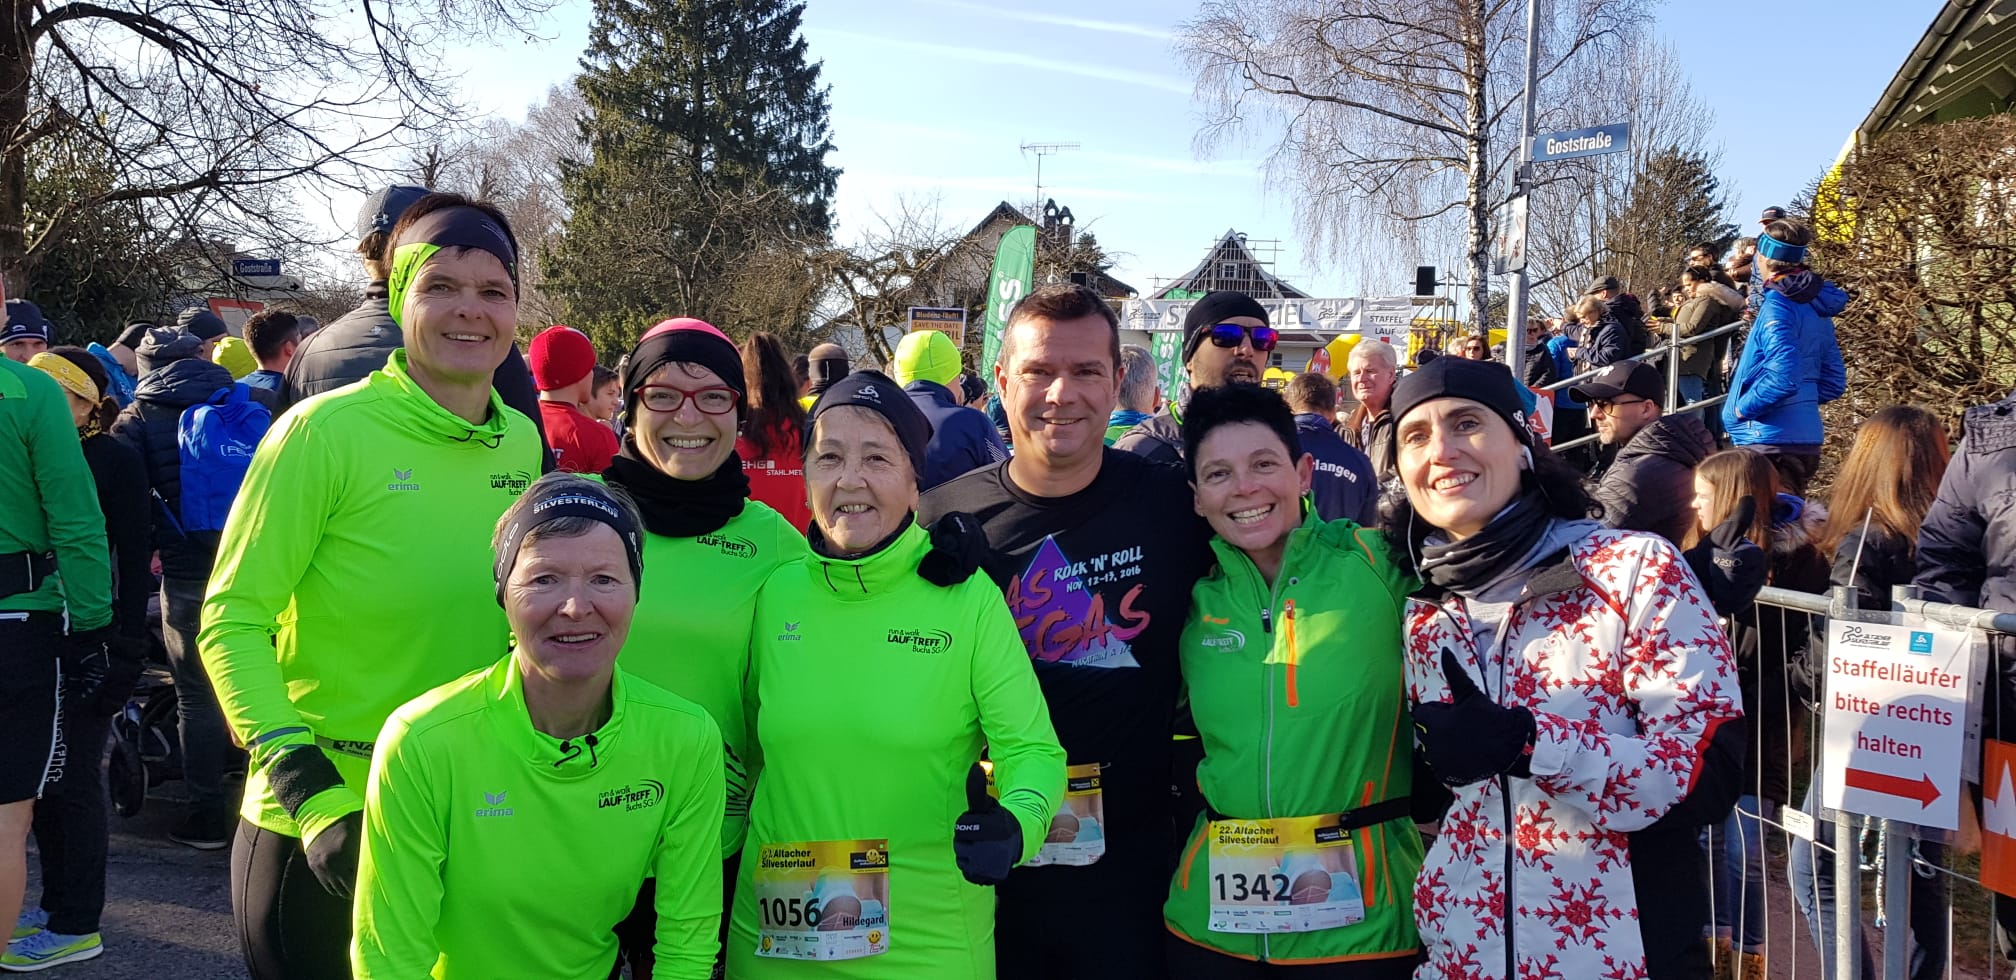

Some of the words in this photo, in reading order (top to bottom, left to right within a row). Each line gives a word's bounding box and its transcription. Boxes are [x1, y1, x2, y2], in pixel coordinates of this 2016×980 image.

[1547, 131, 1612, 155] Goststraße
[1370, 315, 1403, 323] STAFFEL
[945, 331, 960, 340] RIL
[1375, 327, 1395, 335] LAUF
[1312, 459, 1357, 483] langen
[388, 482, 420, 491] erima
[490, 480, 527, 489] LAUF-TREFF
[696, 535, 746, 552] LAUF-TREFF
[1054, 561, 1087, 582] ROCK
[1112, 546, 1143, 567] ROLL
[1066, 581, 1083, 593] NOV
[1088, 571, 1117, 586] 12-13,
[1120, 565, 1141, 579] 2016
[1006, 568, 1052, 614] AS
[777, 633, 801, 641] erima
[887, 634, 941, 647] LAUF-TREFF
[912, 645, 931, 654] Buchs
[931, 646, 941, 654] SG
[1832, 656, 1961, 688] Staffelläufer
[1835, 691, 1880, 715] bitte
[1887, 703, 1952, 726] rechts
[1857, 730, 1922, 759] halten
[599, 789, 609, 798] run
[615, 785, 631, 796] walk
[599, 789, 651, 808] LAUF-TREFF
[626, 801, 642, 812] Buchs
[643, 798, 654, 808] SG
[475, 807, 513, 817] erima
[1219, 826, 1233, 835] 22.
[1234, 826, 1274, 835] Altacher
[1219, 835, 1279, 844] Silvesterlauf
[774, 849, 811, 858] Altacher
[762, 858, 816, 868] Silvesterlauf
[1215, 873, 1292, 902] 1342
[760, 898, 821, 927] 1056
[843, 915, 884, 927] Hildegard
